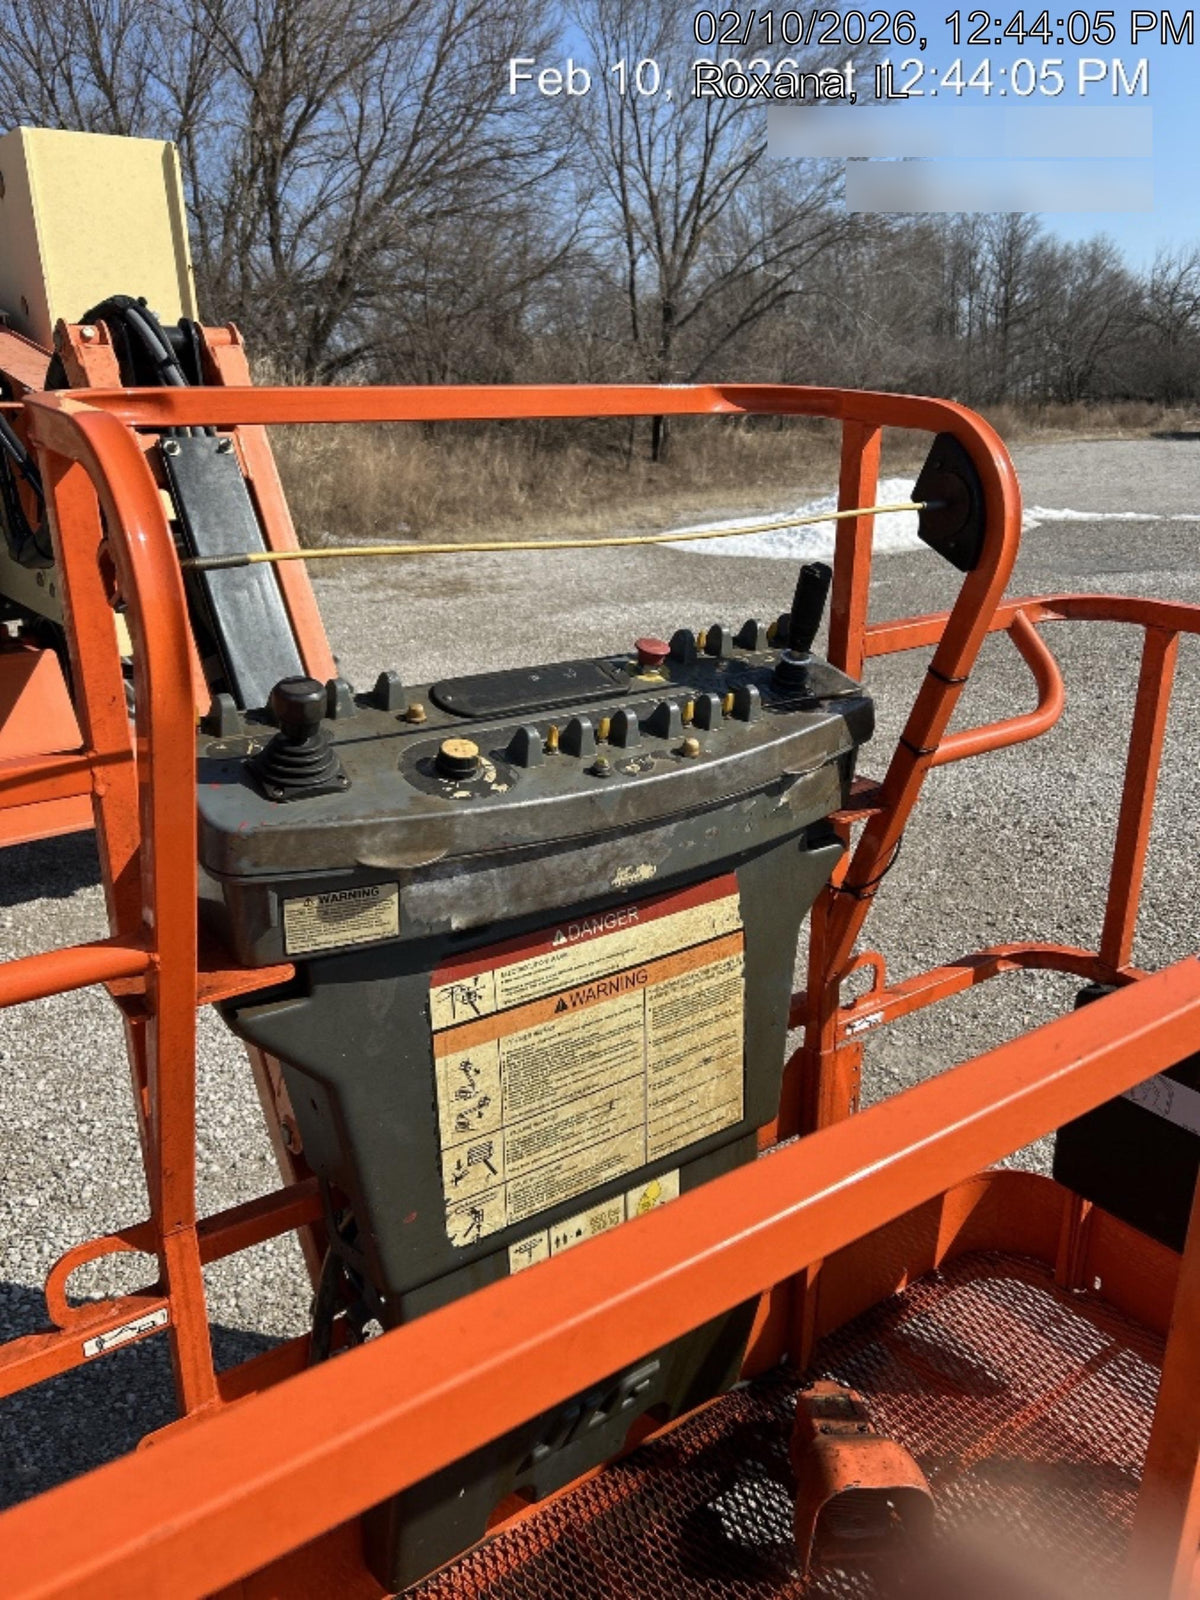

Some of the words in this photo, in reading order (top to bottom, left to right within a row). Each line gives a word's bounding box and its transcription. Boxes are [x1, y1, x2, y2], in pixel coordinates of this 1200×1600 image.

[317, 886, 380, 905] WARNING
[567, 906, 640, 941] DANGER
[569, 967, 649, 1008] WARNING
